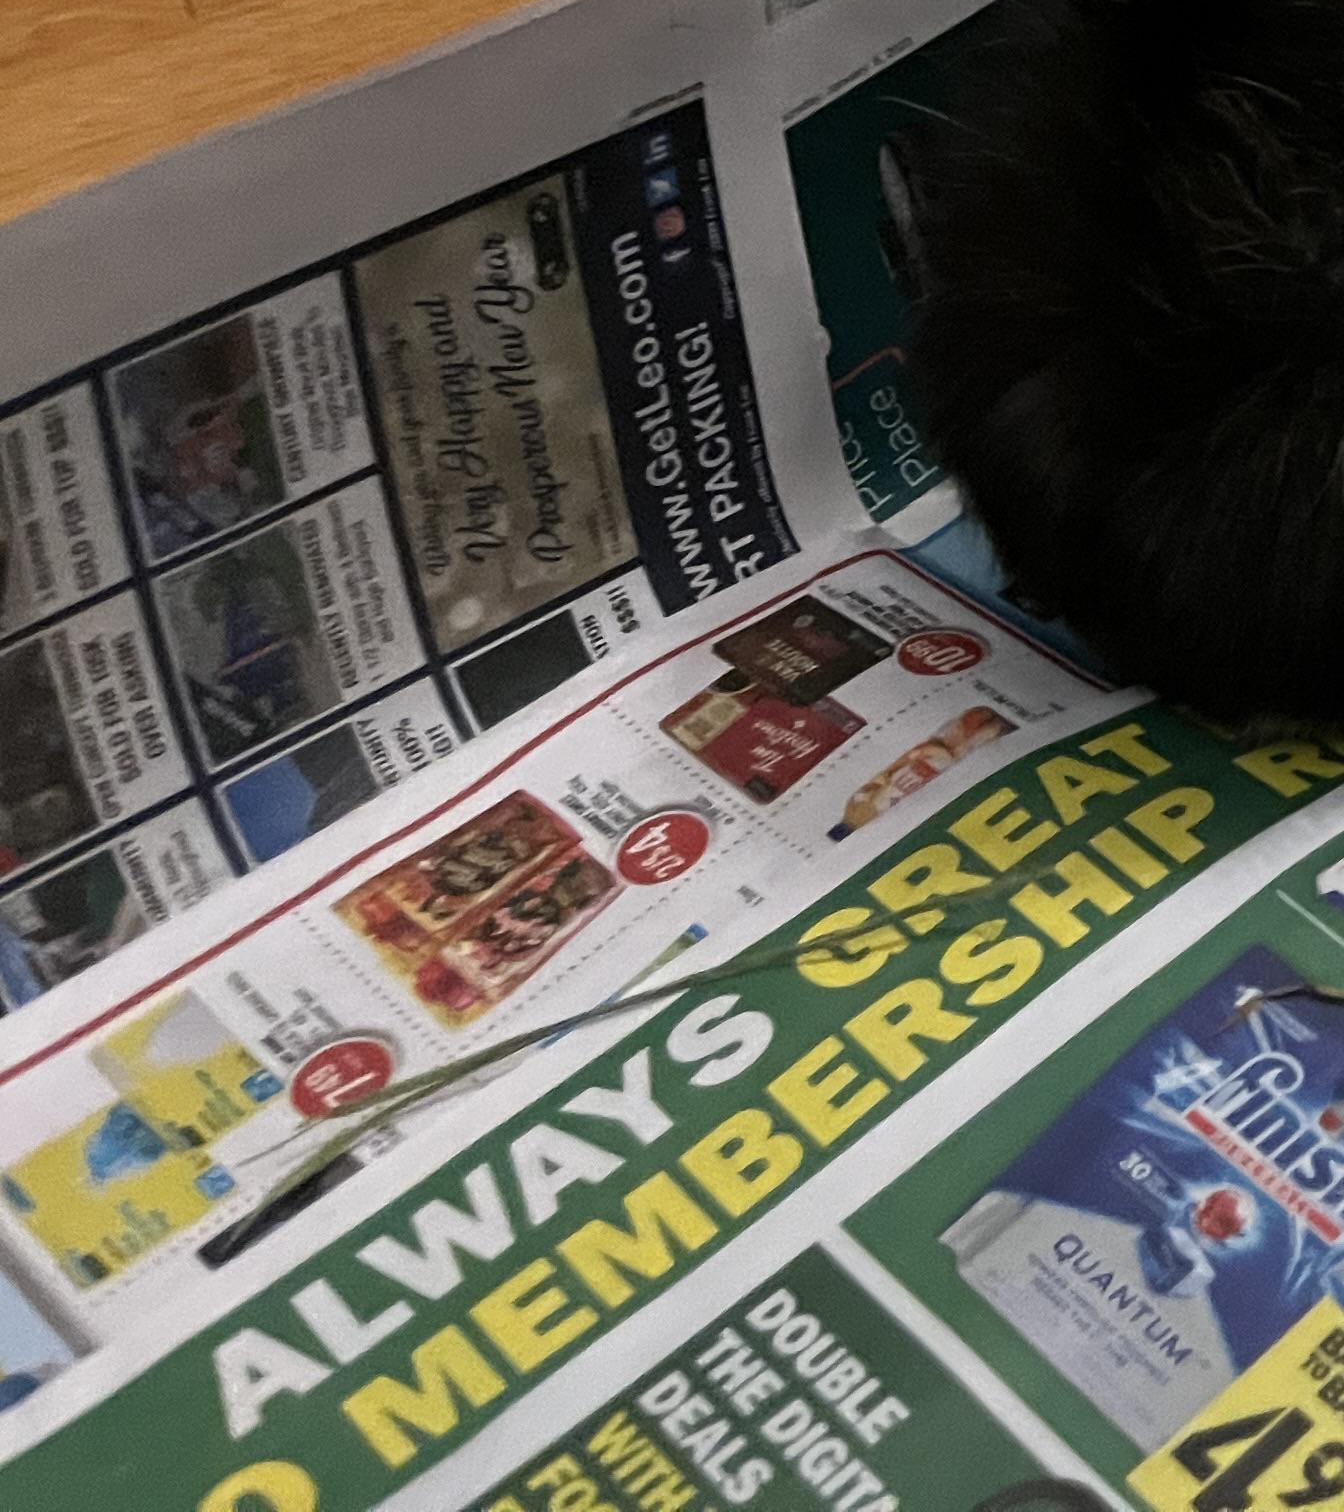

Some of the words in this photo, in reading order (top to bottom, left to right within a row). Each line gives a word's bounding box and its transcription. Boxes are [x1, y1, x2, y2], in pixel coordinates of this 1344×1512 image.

[414, 291, 460, 358] and
[481, 231, 537, 328] Year
[495, 325, 538, 400] New
[608, 231, 722, 599] www.GetLeo.com
[438, 358, 490, 484] Happy
[678, 321, 744, 522] PACKING!
[868, 384, 938, 488] Place
[459, 483, 505, 565] Very
[212, 993, 775, 1440] ALWAYS
[796, 721, 1173, 988] GREAT
[342, 786, 1217, 1469] MEMBERSHIP
[1052, 1232, 1195, 1369] QUANTUM
[696, 1326, 786, 1416] THE
[745, 1288, 911, 1448] DOUBLE
[1298, 1350, 1332, 1382] TO
[586, 1409, 699, 1512] WITH
[637, 1368, 776, 1506] DEALS
